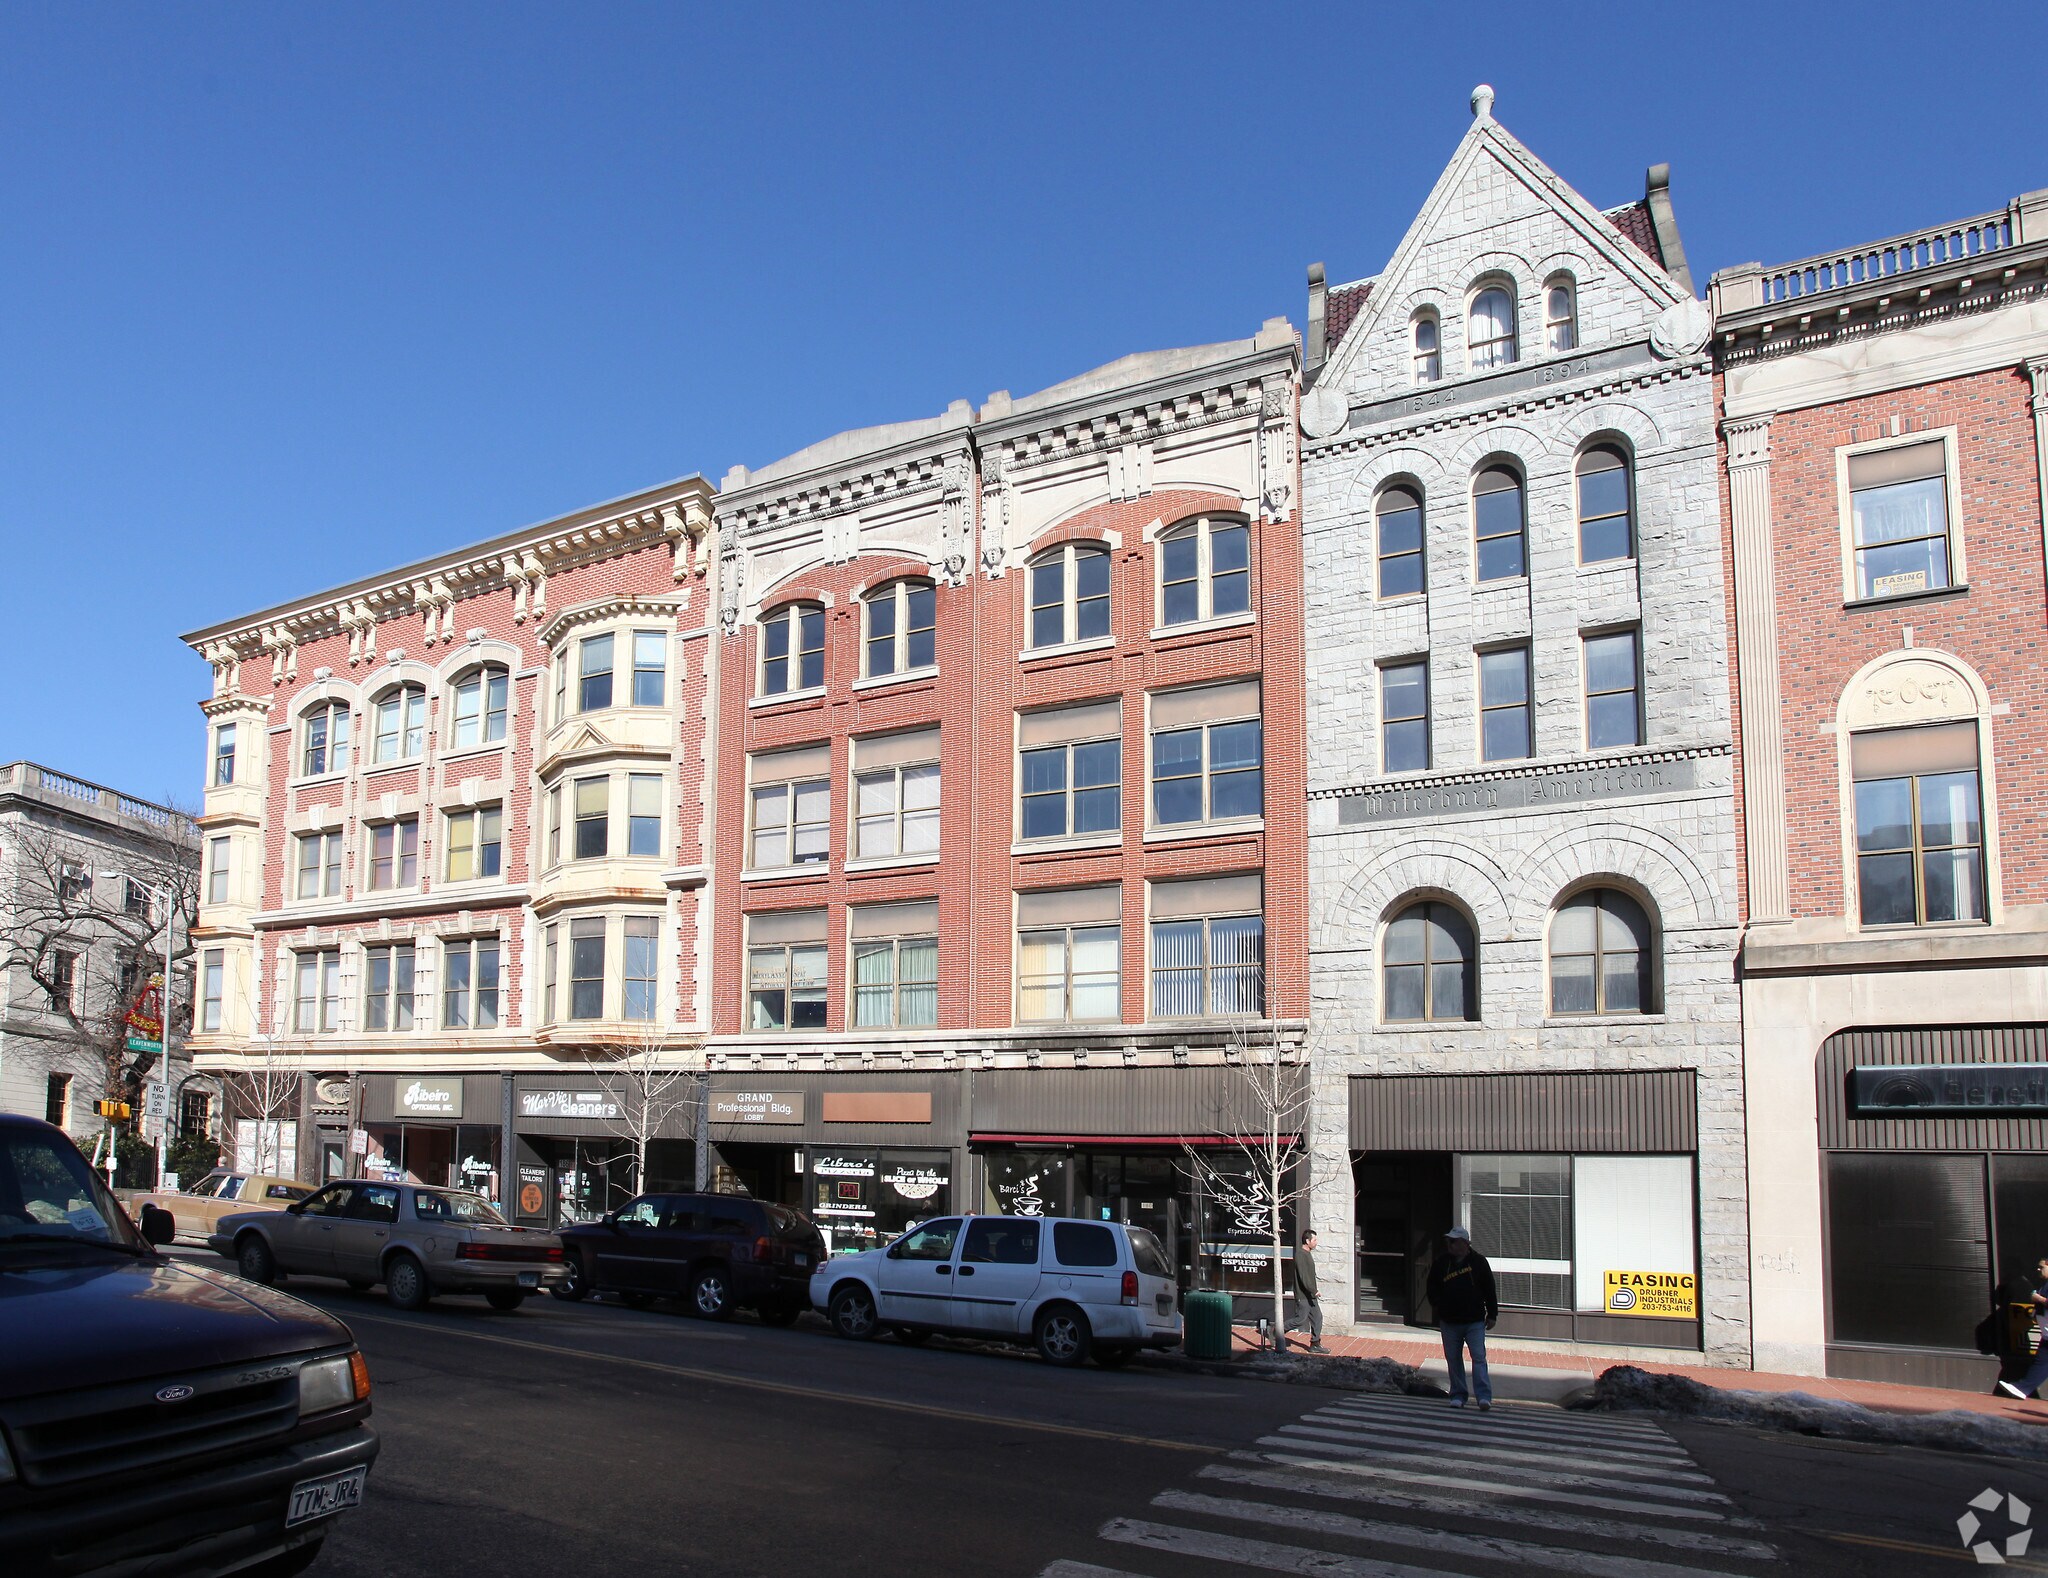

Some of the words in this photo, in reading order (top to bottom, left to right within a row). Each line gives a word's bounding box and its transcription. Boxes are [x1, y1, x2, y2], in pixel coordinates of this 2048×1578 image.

[1404, 389, 1456, 413] 1844
[1534, 360, 1590, 385] 1894
[1875, 572, 1923, 585] LEASING
[1363, 786, 1498, 816] Waterbury
[129, 1039, 162, 1049] LEAVENWORTH
[153, 1085, 164, 1093] NO
[403, 1081, 450, 1106] Ribeiro
[737, 1093, 773, 1103] GRAND
[717, 1103, 766, 1112] Professional
[771, 1103, 793, 1115] Bldg.
[461, 1155, 492, 1171] Ribeiro
[520, 1168, 546, 1176] CLEANERS
[927, 1168, 937, 1177] the
[521, 1174, 543, 1183] TAILORS
[839, 1183, 858, 1197] OPEN
[819, 1202, 867, 1210] GRINDERS
[1227, 1228, 1252, 1236] Espresso
[1221, 1252, 1266, 1260] CAPPUCCINO
[1221, 1258, 1267, 1267] ESPRESSO
[1233, 1265, 1258, 1273] LATTE
[1608, 1273, 1693, 1288] LEASING
[1639, 1289, 1679, 1297] DRUBNER
[1639, 1296, 1693, 1305] INDUSTRIALS
[1641, 1303, 1692, 1312] 203-753-4116
